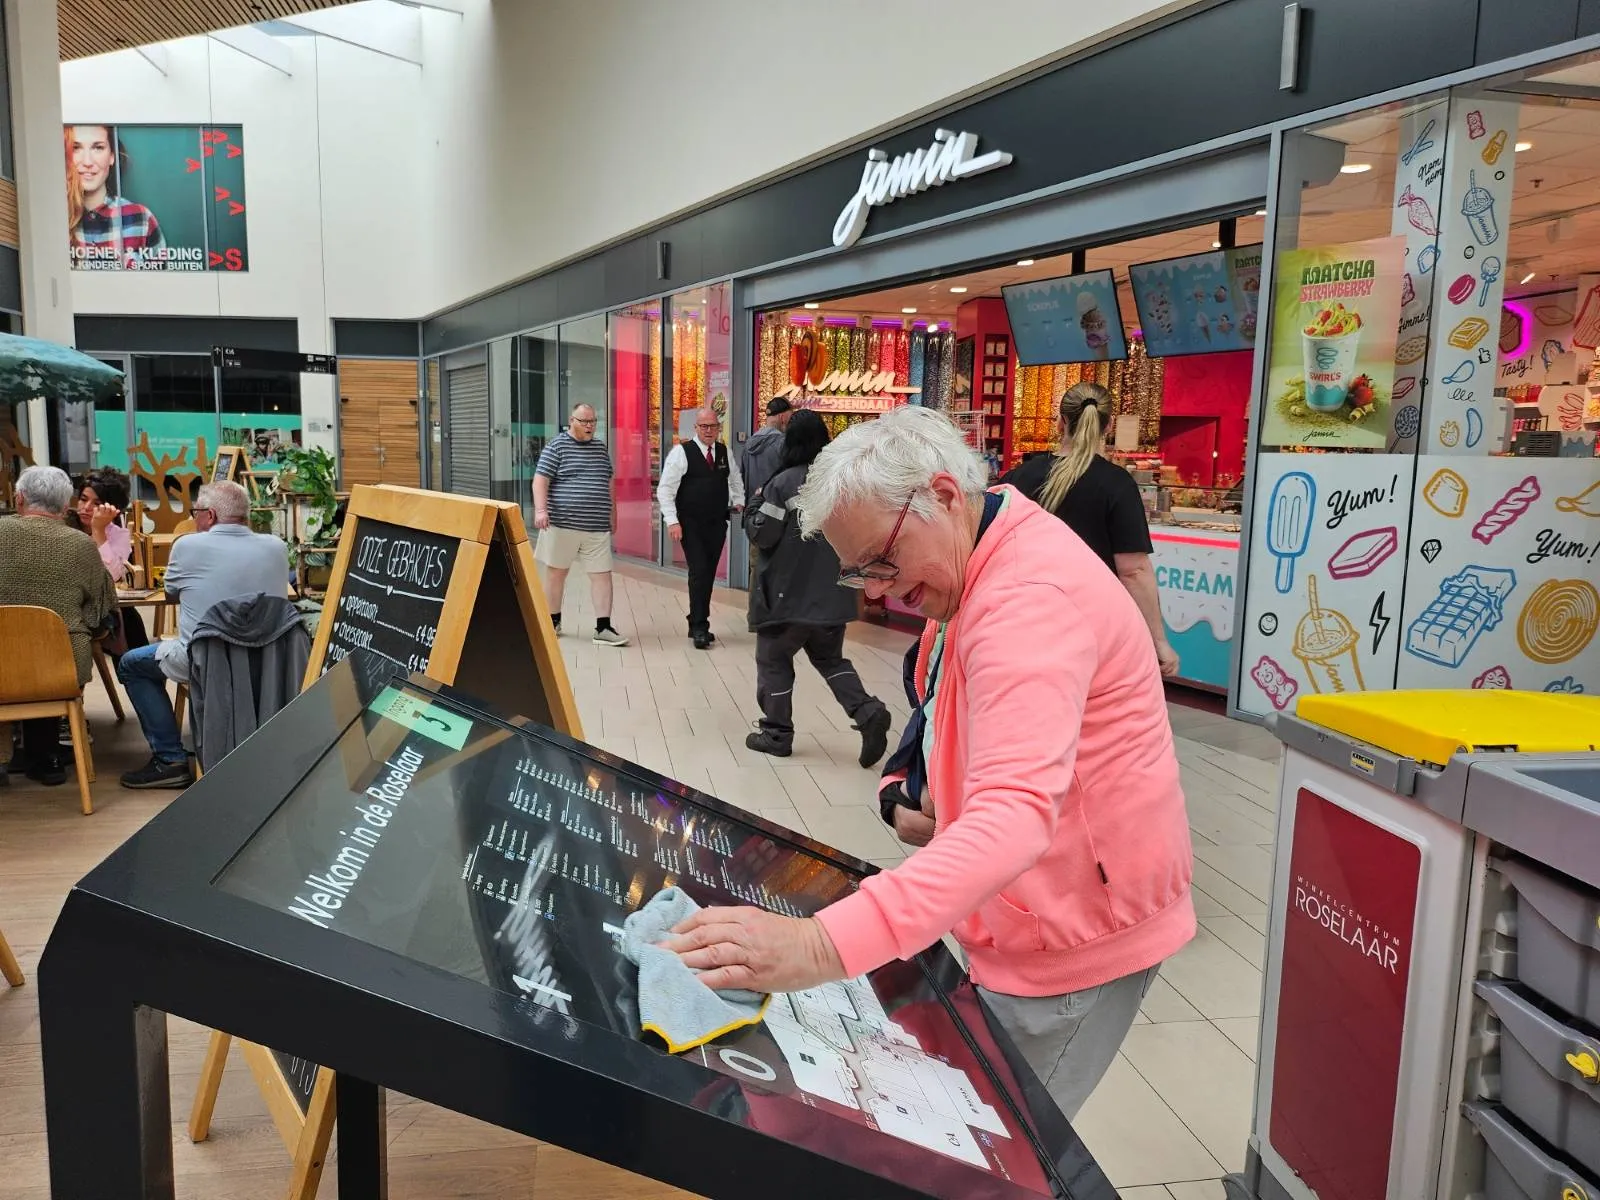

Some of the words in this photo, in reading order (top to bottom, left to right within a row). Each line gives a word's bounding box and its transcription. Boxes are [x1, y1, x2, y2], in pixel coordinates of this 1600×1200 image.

[832, 127, 1013, 250] jamin
[131, 260, 164, 271] SPORT
[168, 260, 203, 271] BUITEN
[139, 247, 202, 261] KLEDING
[1235, 255, 1262, 268] MATC
[1301, 259, 1375, 286] MATCHA
[1299, 279, 1374, 304] STRAWBERRY
[1501, 354, 1534, 378] Tasty!
[1303, 429, 1341, 442] jamin
[1326, 473, 1398, 530] Yum!
[1526, 528, 1600, 564] Yum!
[387, 540, 447, 589] GEBAKJES
[1155, 564, 1234, 598] CREAM
[366, 745, 425, 807] Roselaar
[355, 803, 393, 828] de
[339, 826, 381, 848] in
[287, 846, 370, 929] Welkom
[1295, 886, 1398, 975] ROSELAAR
